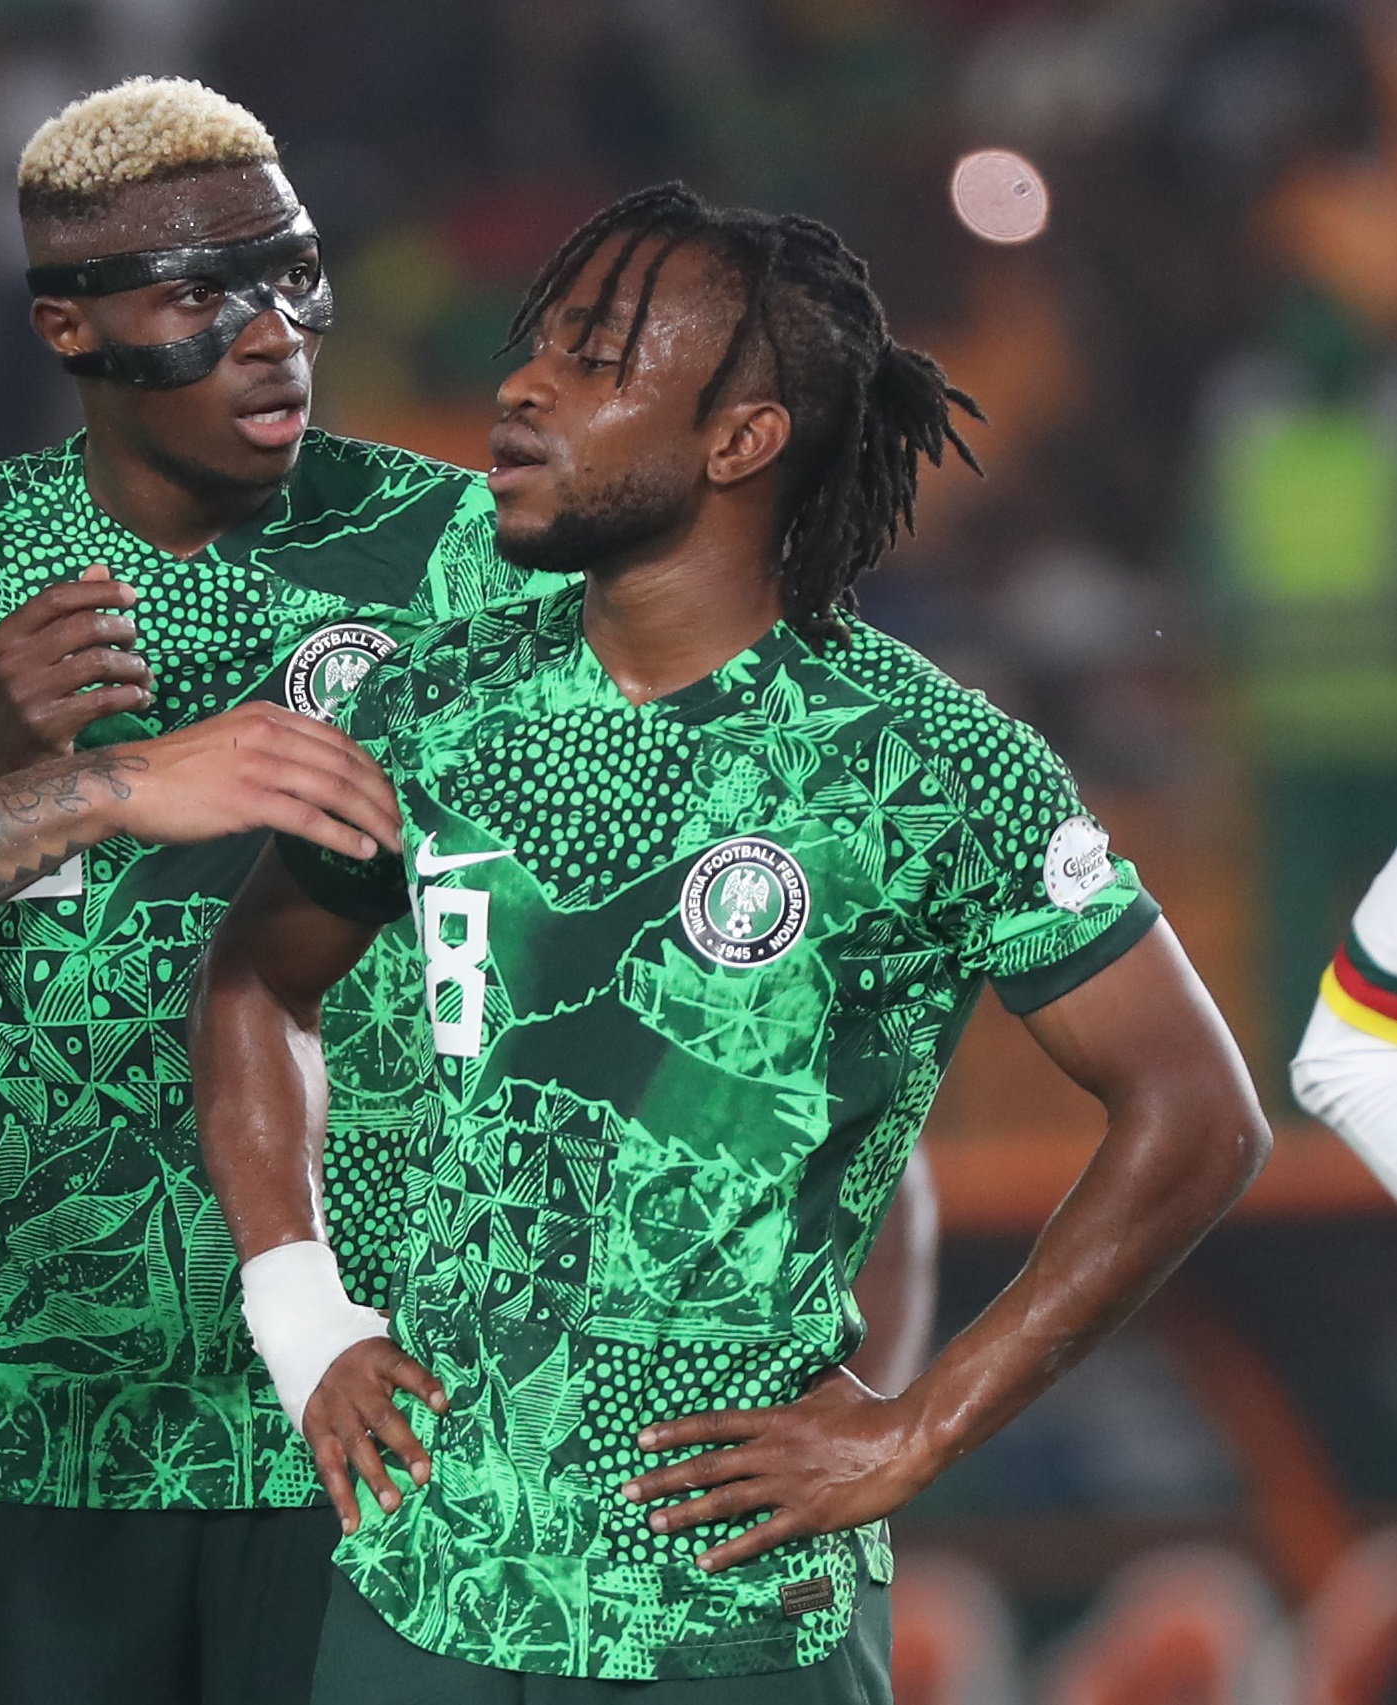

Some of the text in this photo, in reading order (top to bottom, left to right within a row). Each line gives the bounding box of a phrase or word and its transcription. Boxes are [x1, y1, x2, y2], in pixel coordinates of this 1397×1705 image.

[299, 631, 369, 670] FOOTBALL
[688, 845, 803, 950] NIGERIA FOOTBALL FEDERATION
[408, 883, 490, 1057] 8
[718, 942, 752, 960] 1945
